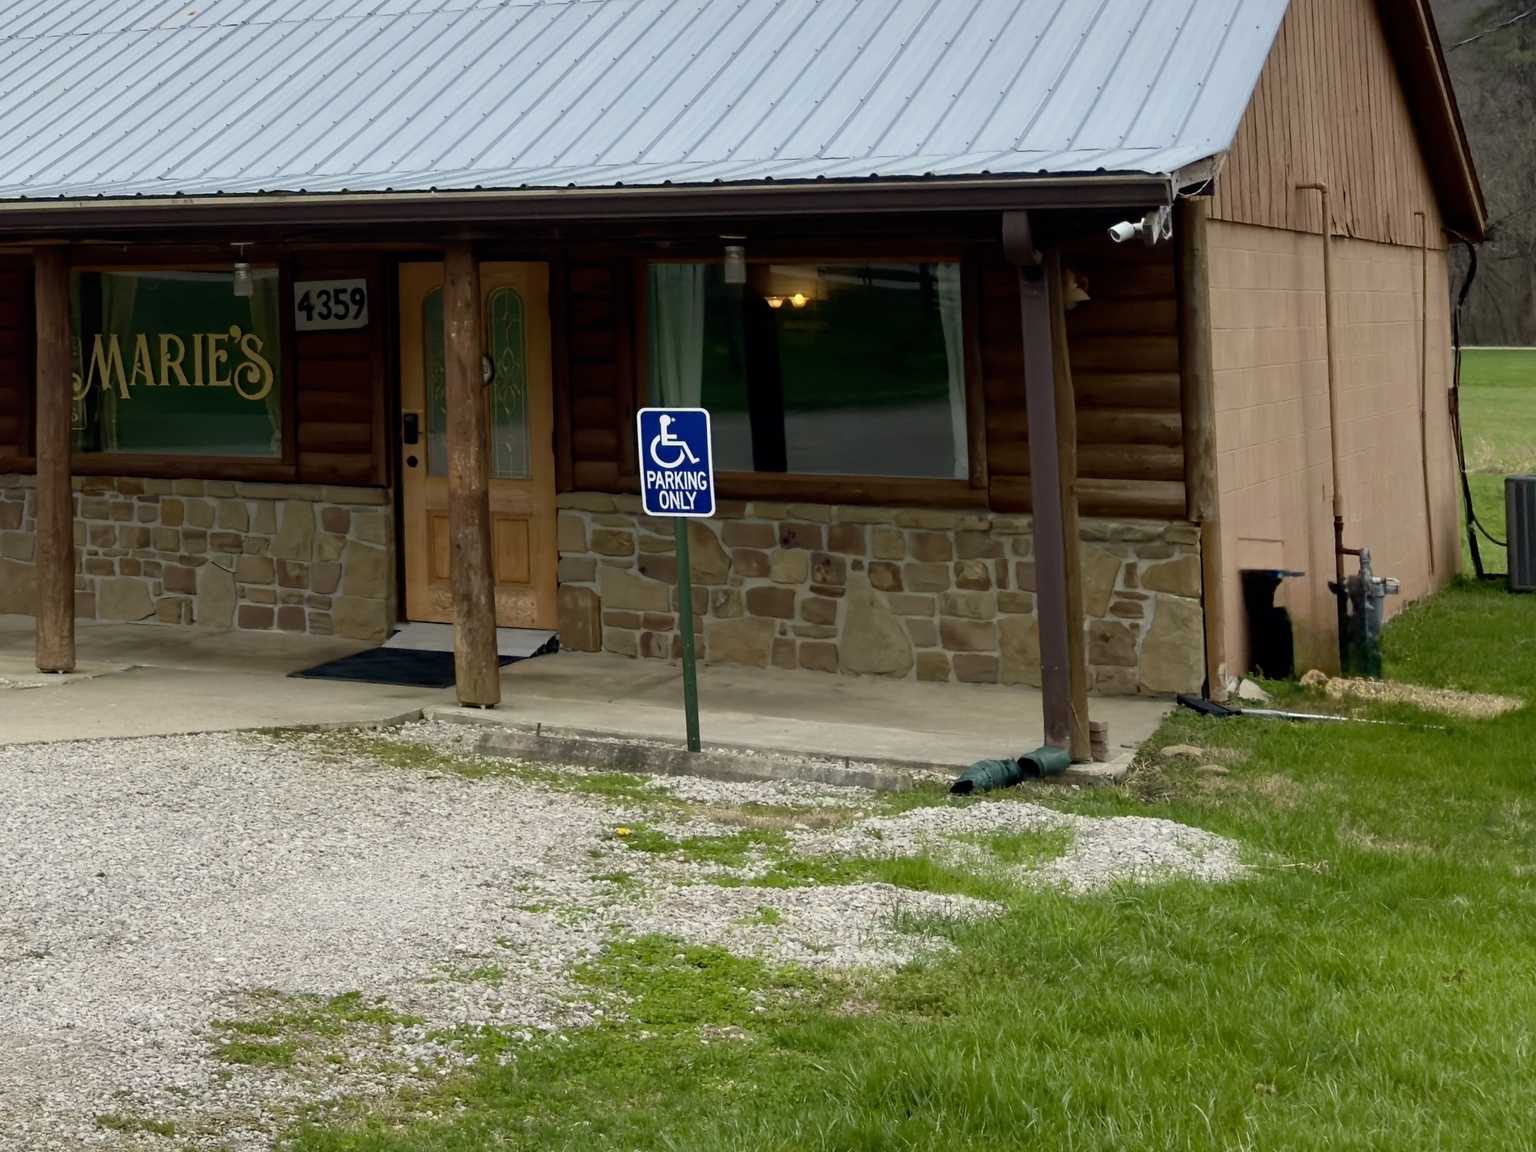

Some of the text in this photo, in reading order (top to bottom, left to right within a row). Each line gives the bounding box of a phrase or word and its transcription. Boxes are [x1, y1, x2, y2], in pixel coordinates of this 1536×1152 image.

[297, 287, 366, 322] 4359
[70, 324, 274, 401] MARIE'S
[646, 470, 708, 491] PARKING
[658, 490, 697, 510] ONLY
